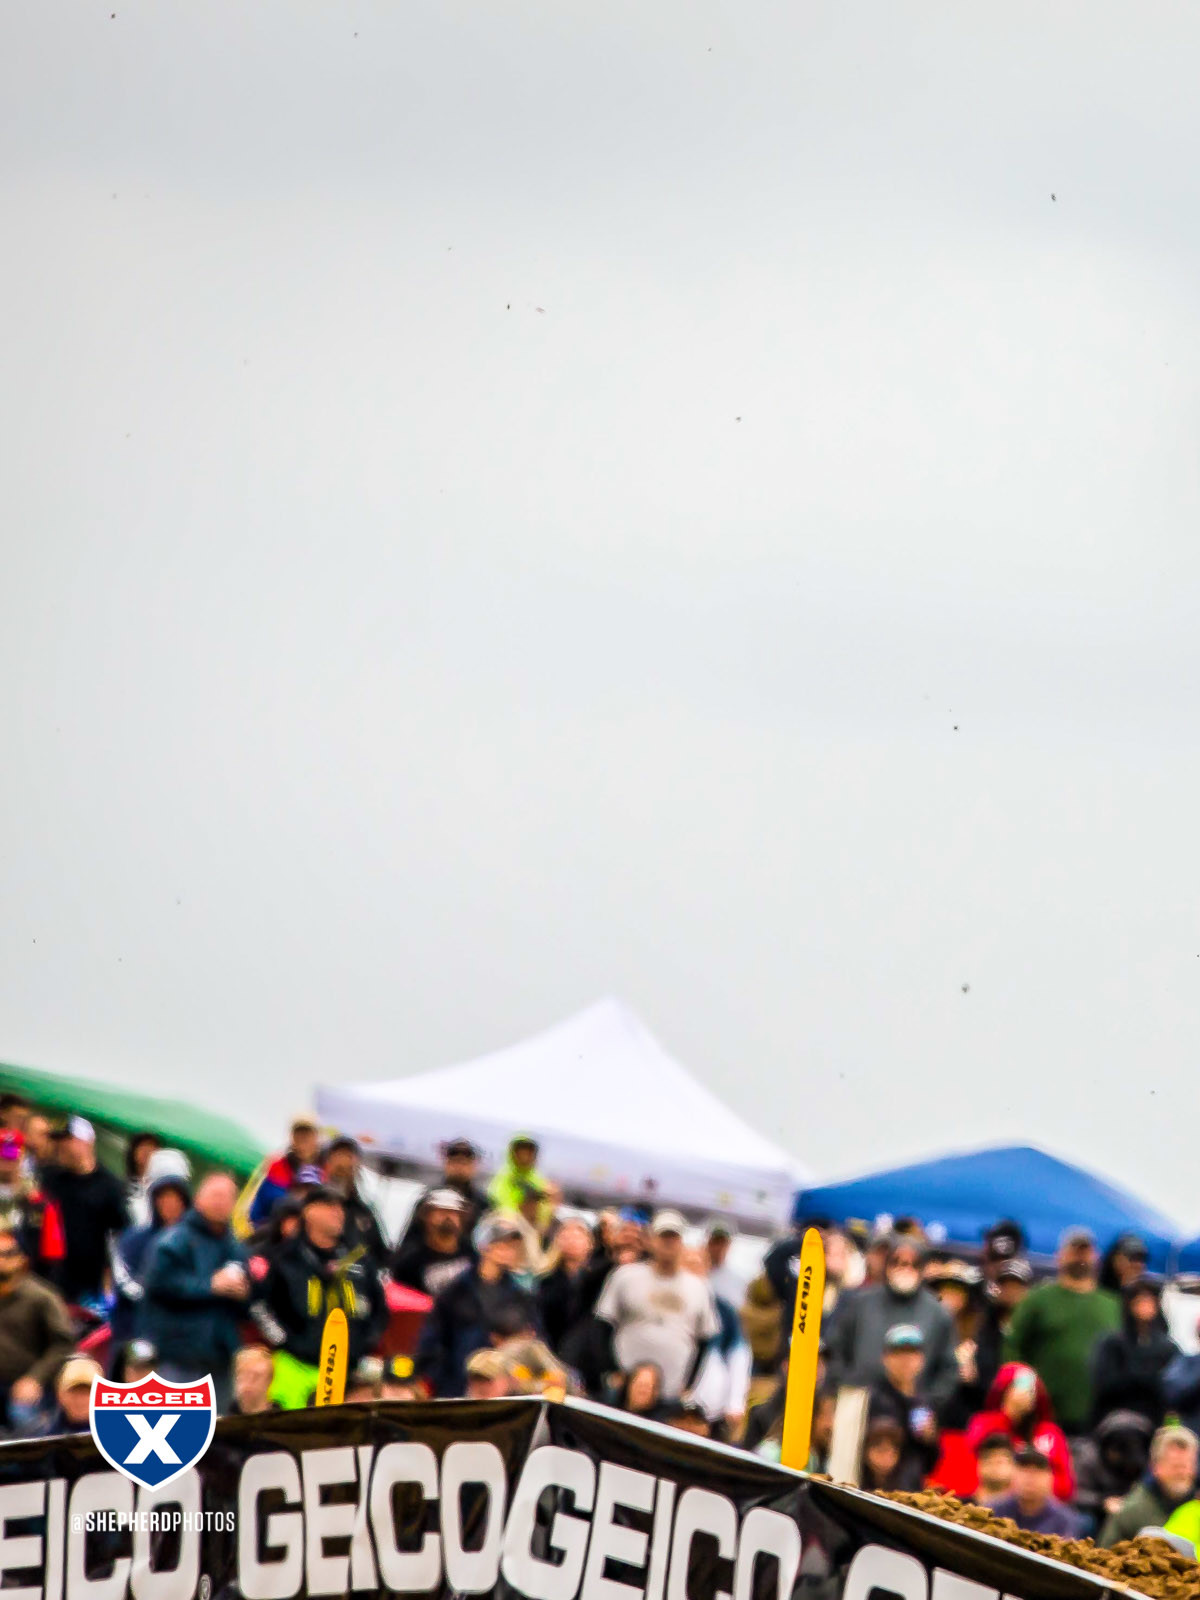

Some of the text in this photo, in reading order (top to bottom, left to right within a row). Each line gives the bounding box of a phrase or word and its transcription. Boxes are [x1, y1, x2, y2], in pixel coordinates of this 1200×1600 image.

[799, 1265, 813, 1334] ACERBIS
[237, 1441, 507, 1600] GEICO
[500, 1445, 802, 1600] GEICO
